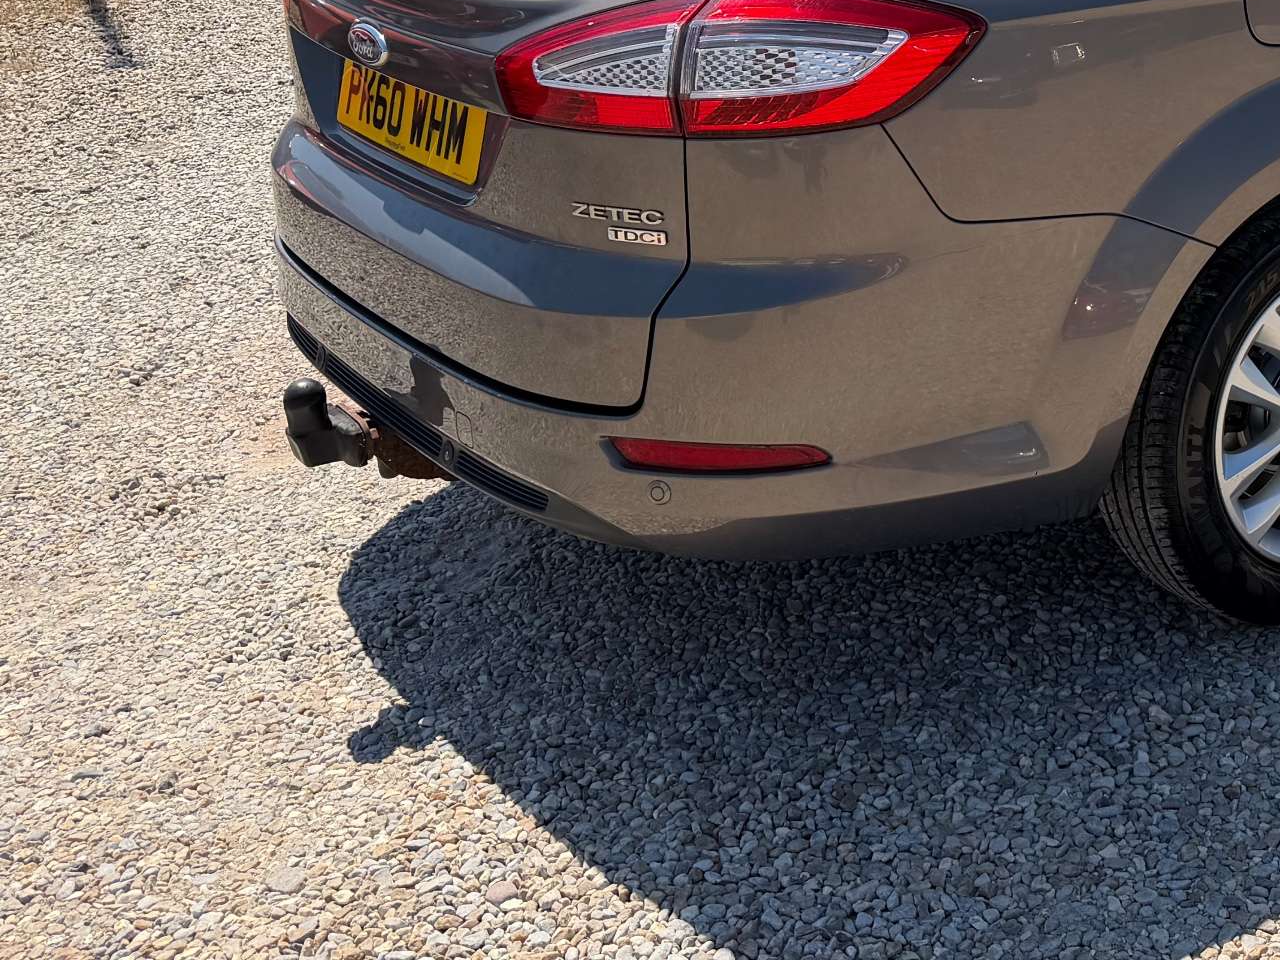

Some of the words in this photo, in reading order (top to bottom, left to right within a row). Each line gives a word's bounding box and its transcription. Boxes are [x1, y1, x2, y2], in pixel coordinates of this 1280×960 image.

[345, 62, 407, 138] PK60
[409, 88, 469, 165] WHM
[570, 201, 664, 225] ZETEC
[608, 228, 663, 244] TDCi
